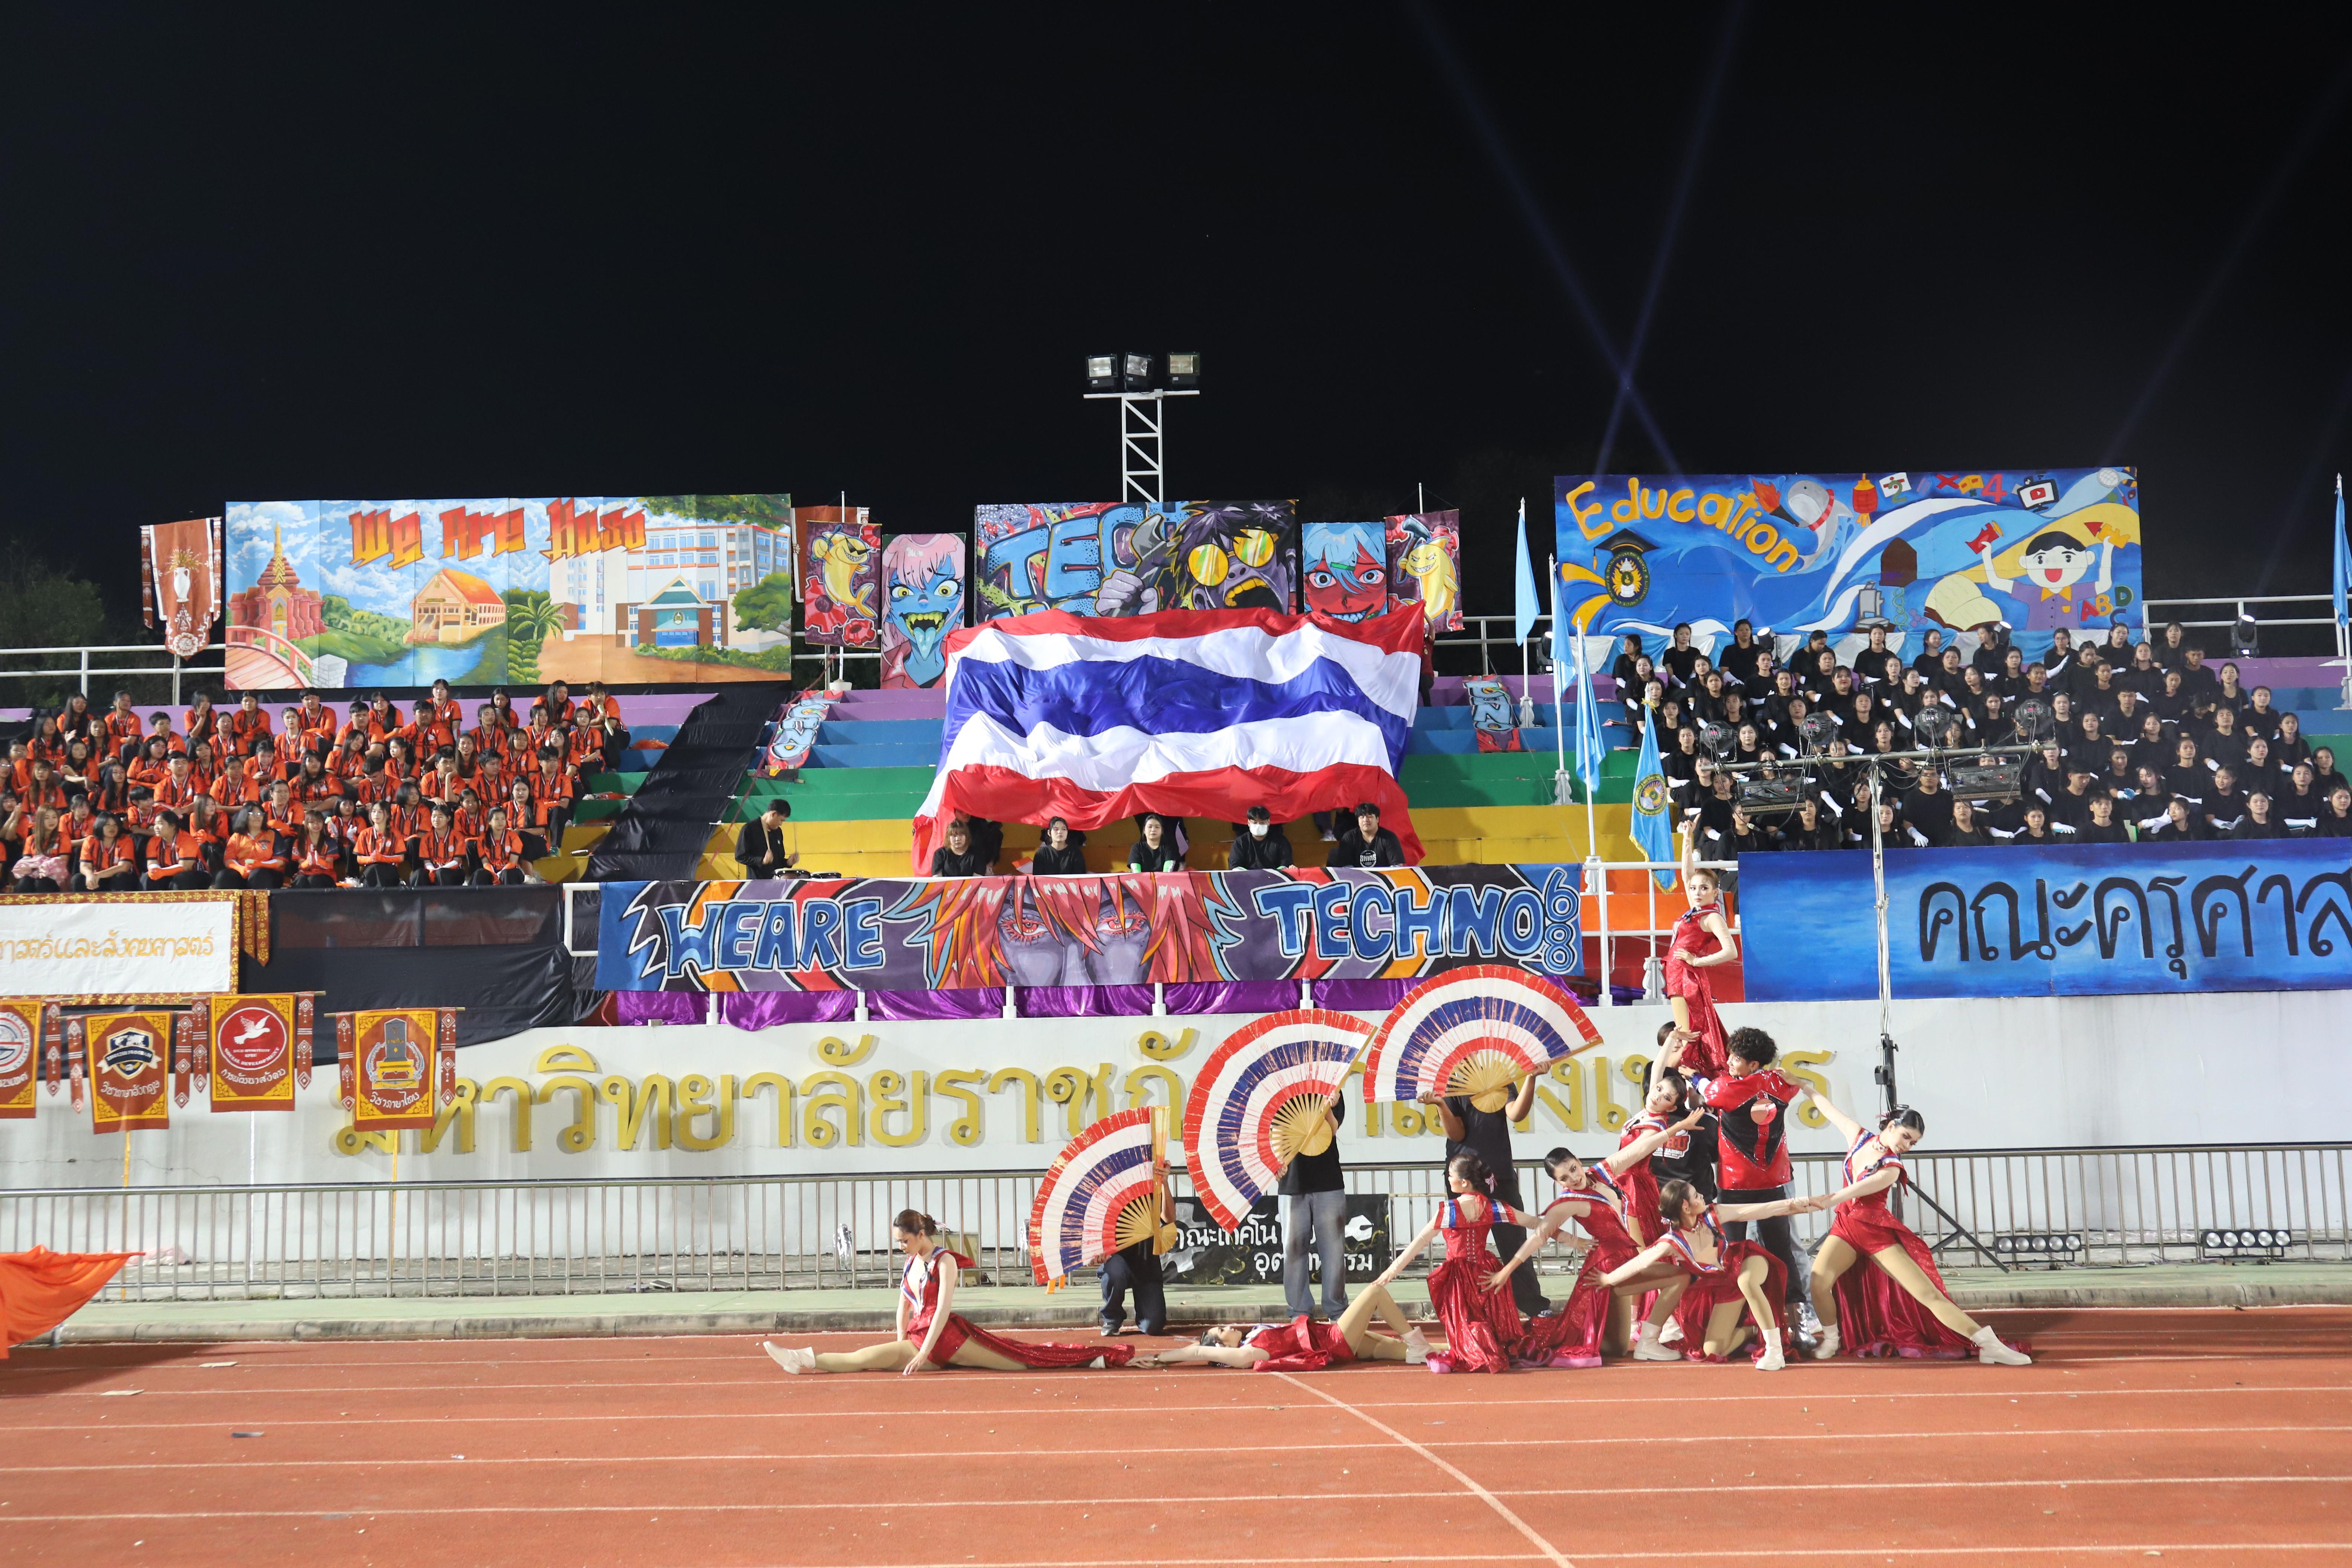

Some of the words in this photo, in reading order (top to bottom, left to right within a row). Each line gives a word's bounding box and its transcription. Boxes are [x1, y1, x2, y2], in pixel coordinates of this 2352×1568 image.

[1566, 477, 1799, 572] Education
[0, 926, 214, 963] าสตร์และสังคมศาสตร์
[1253, 882, 1545, 959] TECHNO
[1919, 865, 2352, 980] คณะครุศาส
[370, 1091, 420, 1109] วิชาภาษาไทย
